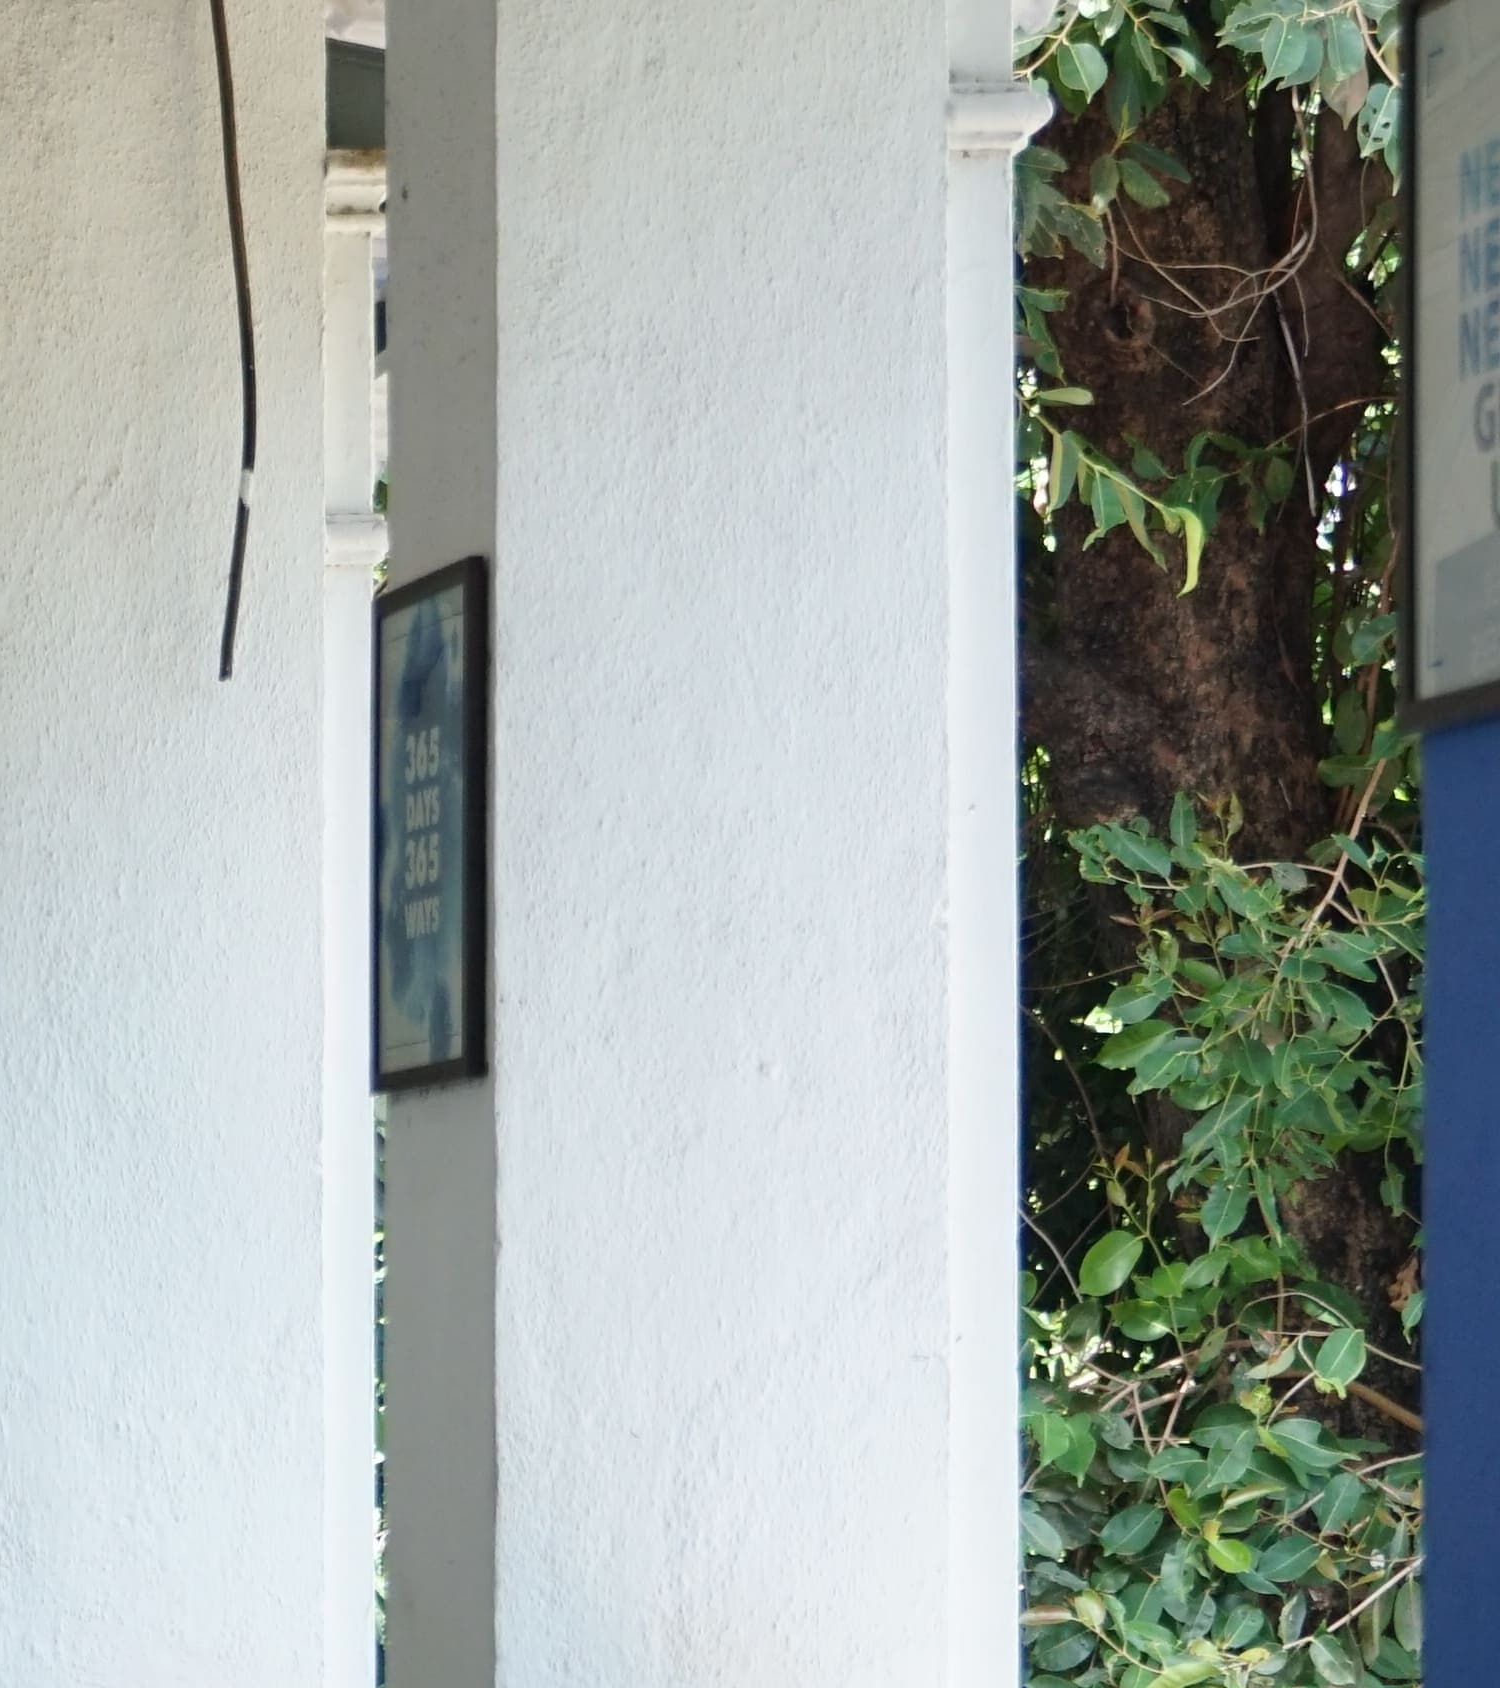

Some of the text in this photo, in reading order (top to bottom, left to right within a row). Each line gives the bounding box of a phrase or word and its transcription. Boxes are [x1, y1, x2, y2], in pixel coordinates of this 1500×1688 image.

[404, 726, 440, 784] 365
[404, 785, 440, 833] DAYS
[404, 832, 439, 892] 365
[404, 893, 440, 940] WAYS
